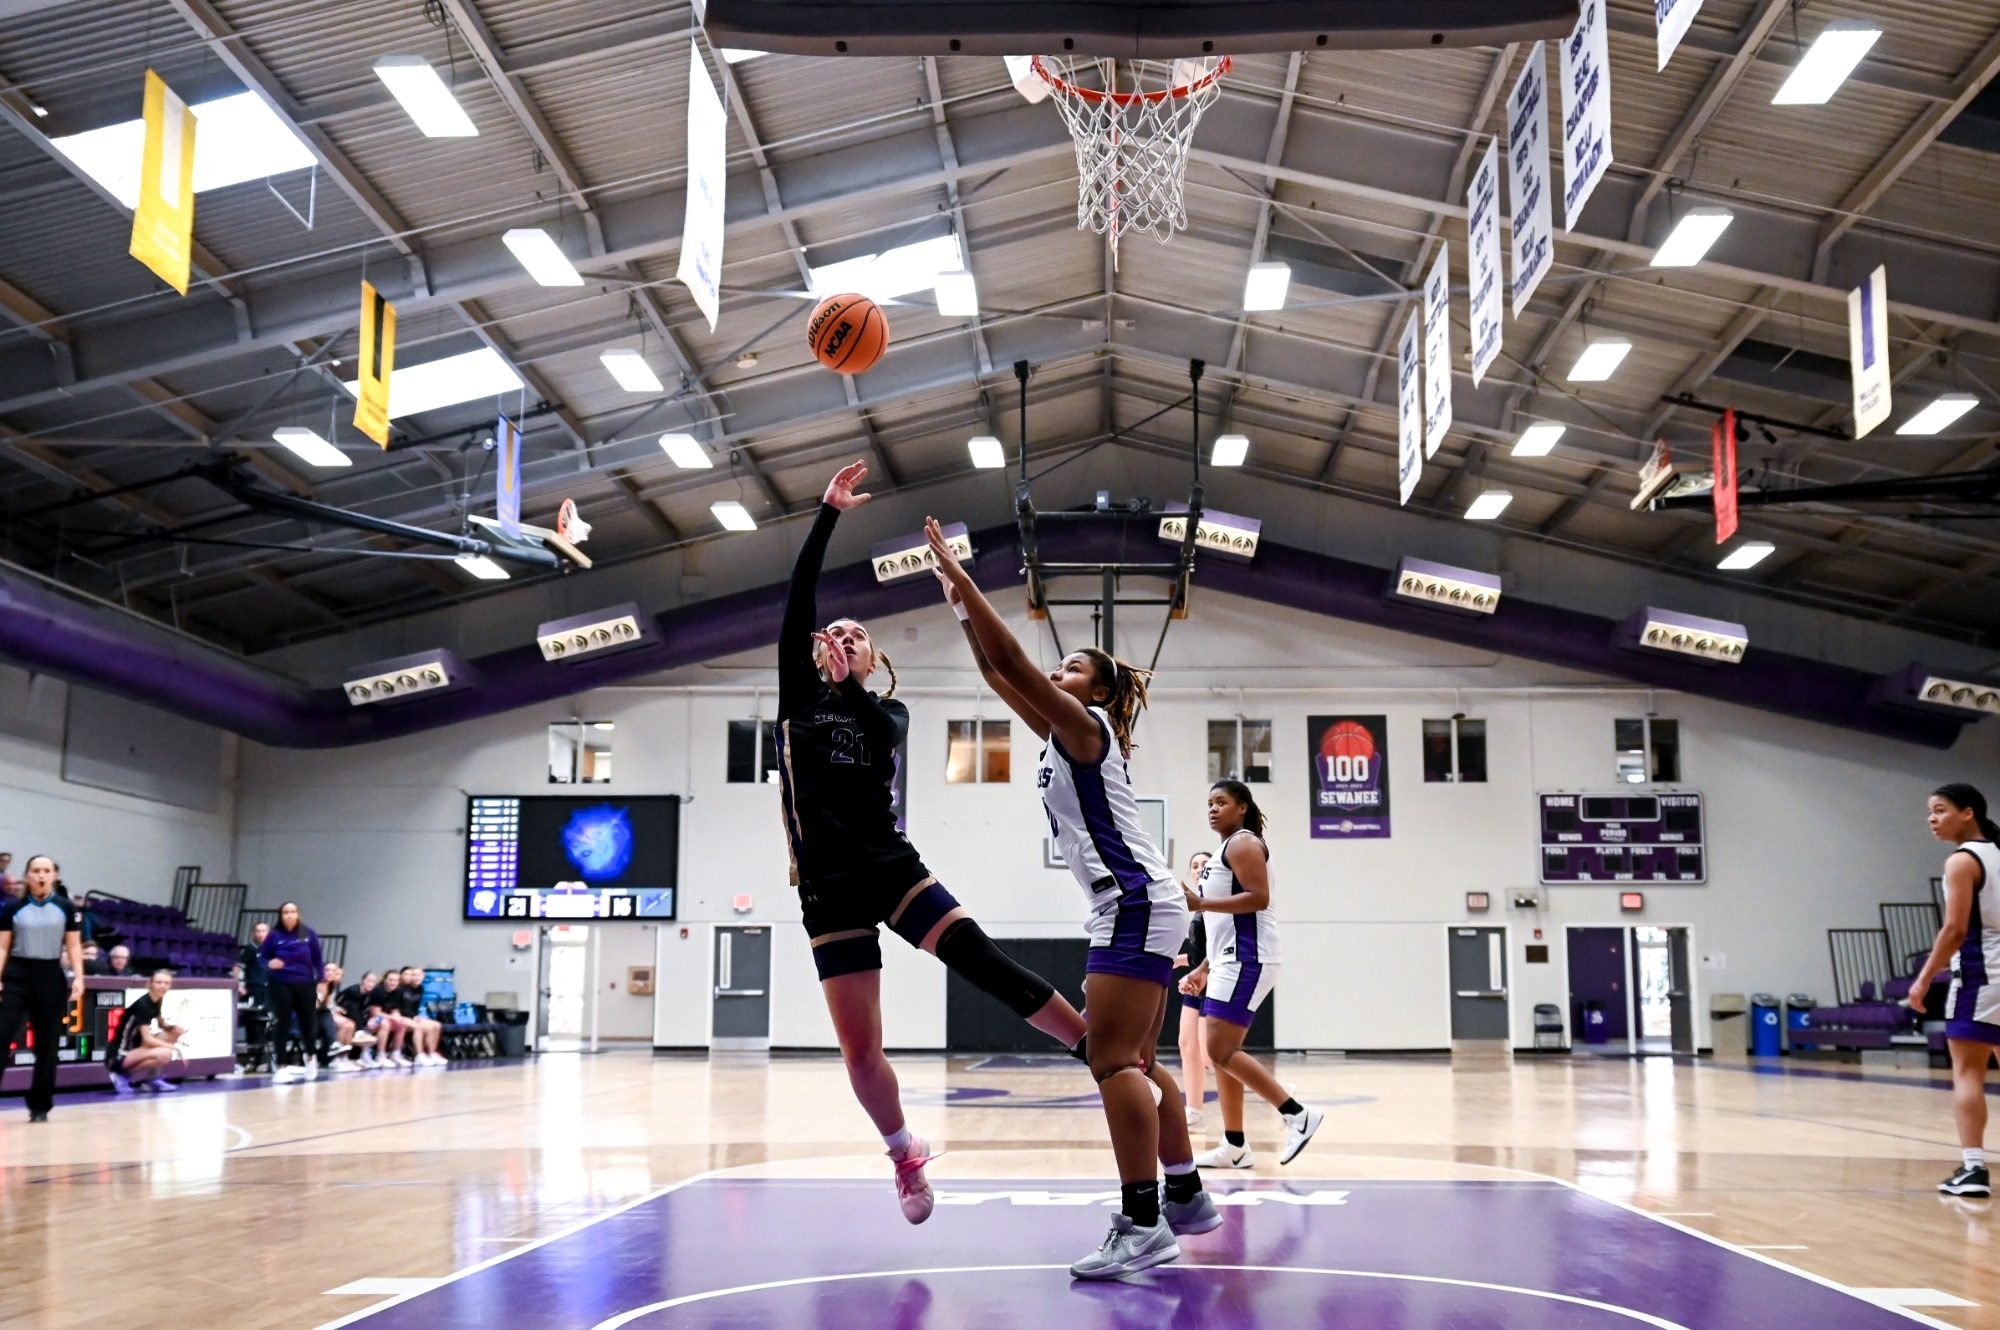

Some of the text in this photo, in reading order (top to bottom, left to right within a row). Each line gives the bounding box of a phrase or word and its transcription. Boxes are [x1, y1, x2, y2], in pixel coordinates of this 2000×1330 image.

[808, 302, 841, 349] Wilson
[824, 320, 852, 359] NCAA
[830, 727, 872, 766] 21
[1327, 755, 1369, 783] 100
[1320, 791, 1379, 805] SEWANEE
[1546, 797, 1699, 807] HOME VISITOR
[1599, 829, 1627, 838] PERIOD
